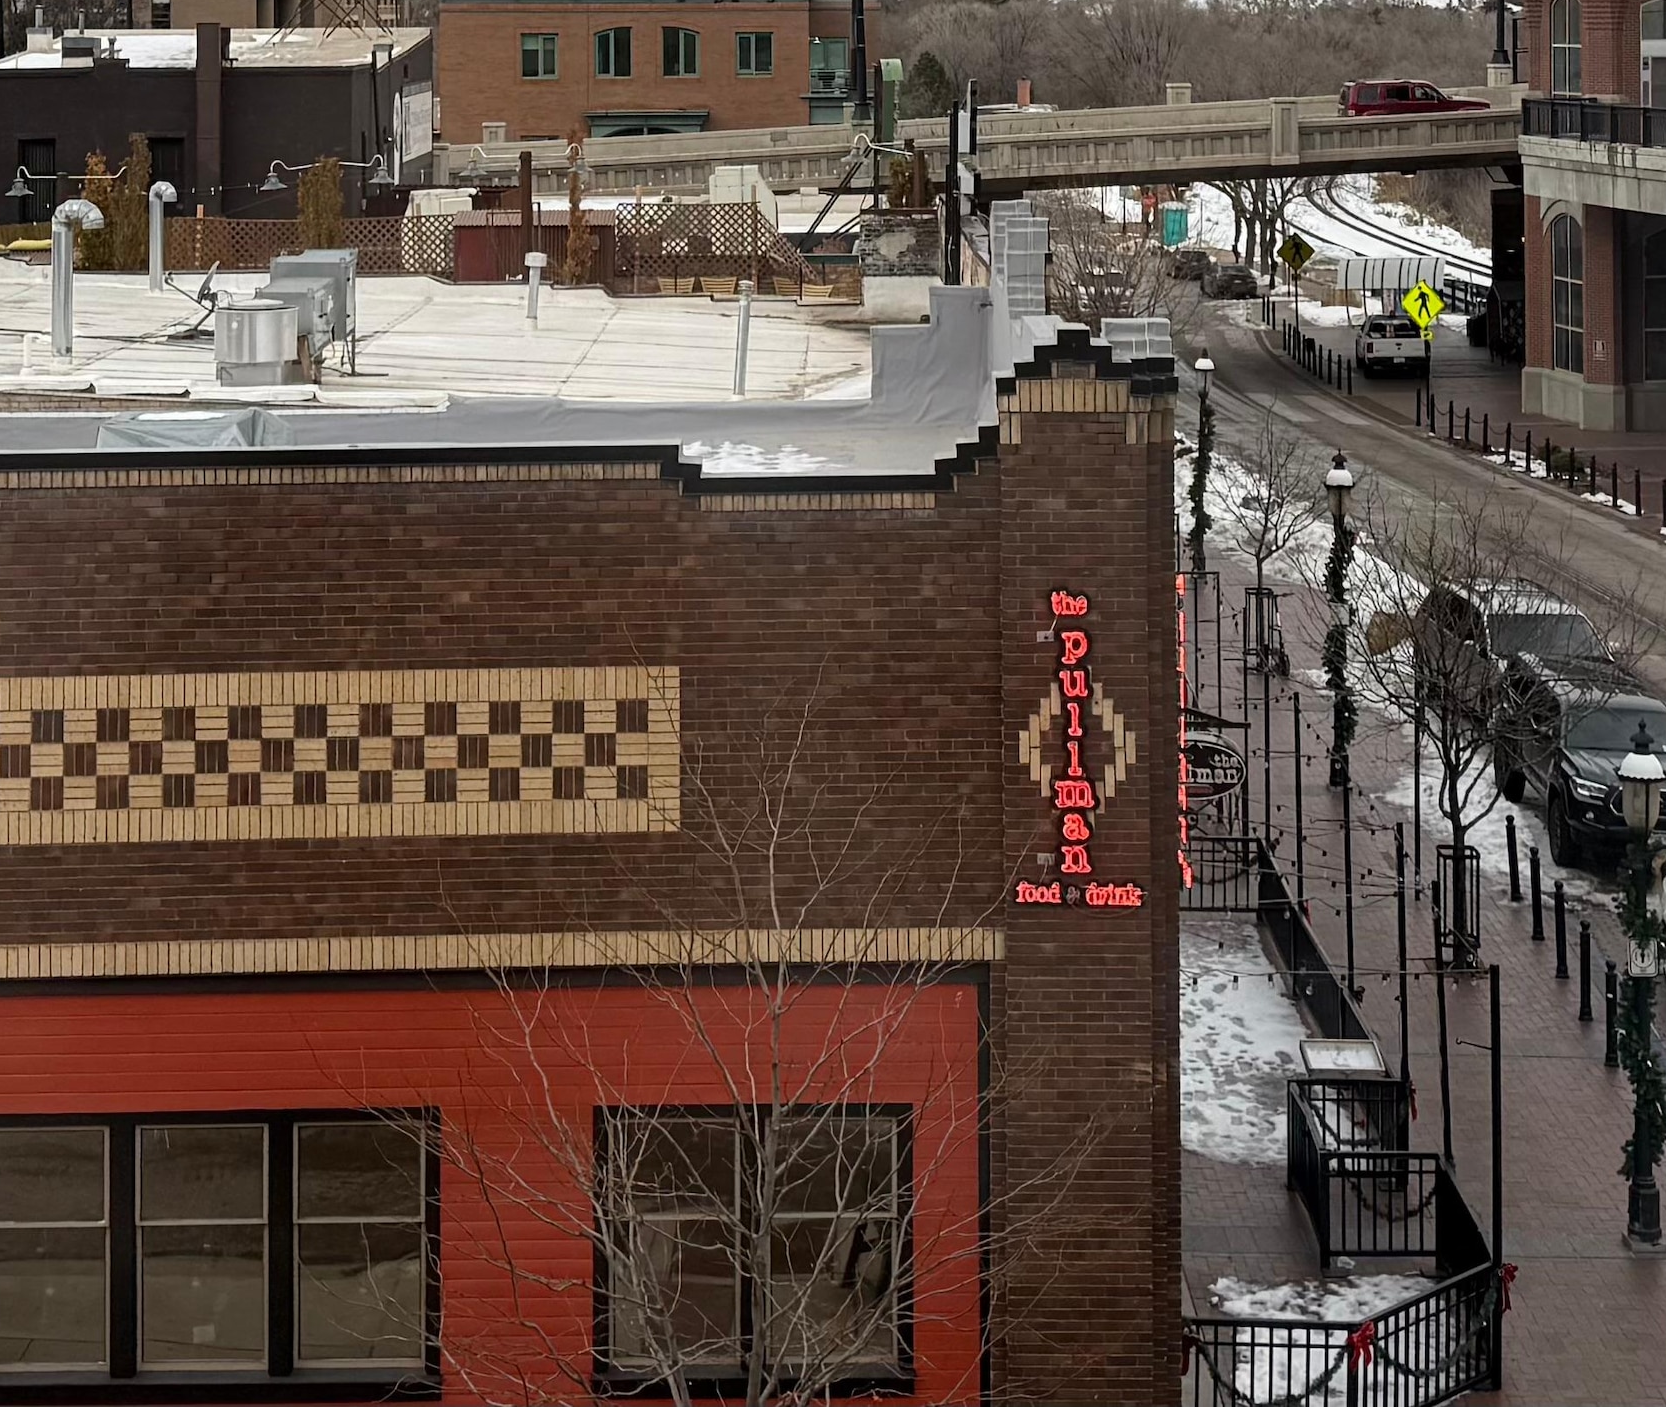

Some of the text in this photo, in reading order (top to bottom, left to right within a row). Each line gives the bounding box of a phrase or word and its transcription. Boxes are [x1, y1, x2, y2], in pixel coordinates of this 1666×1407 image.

[1051, 591, 1088, 616] the
[1054, 630, 1096, 874] pullman
[1016, 881, 1142, 906] food & drink
